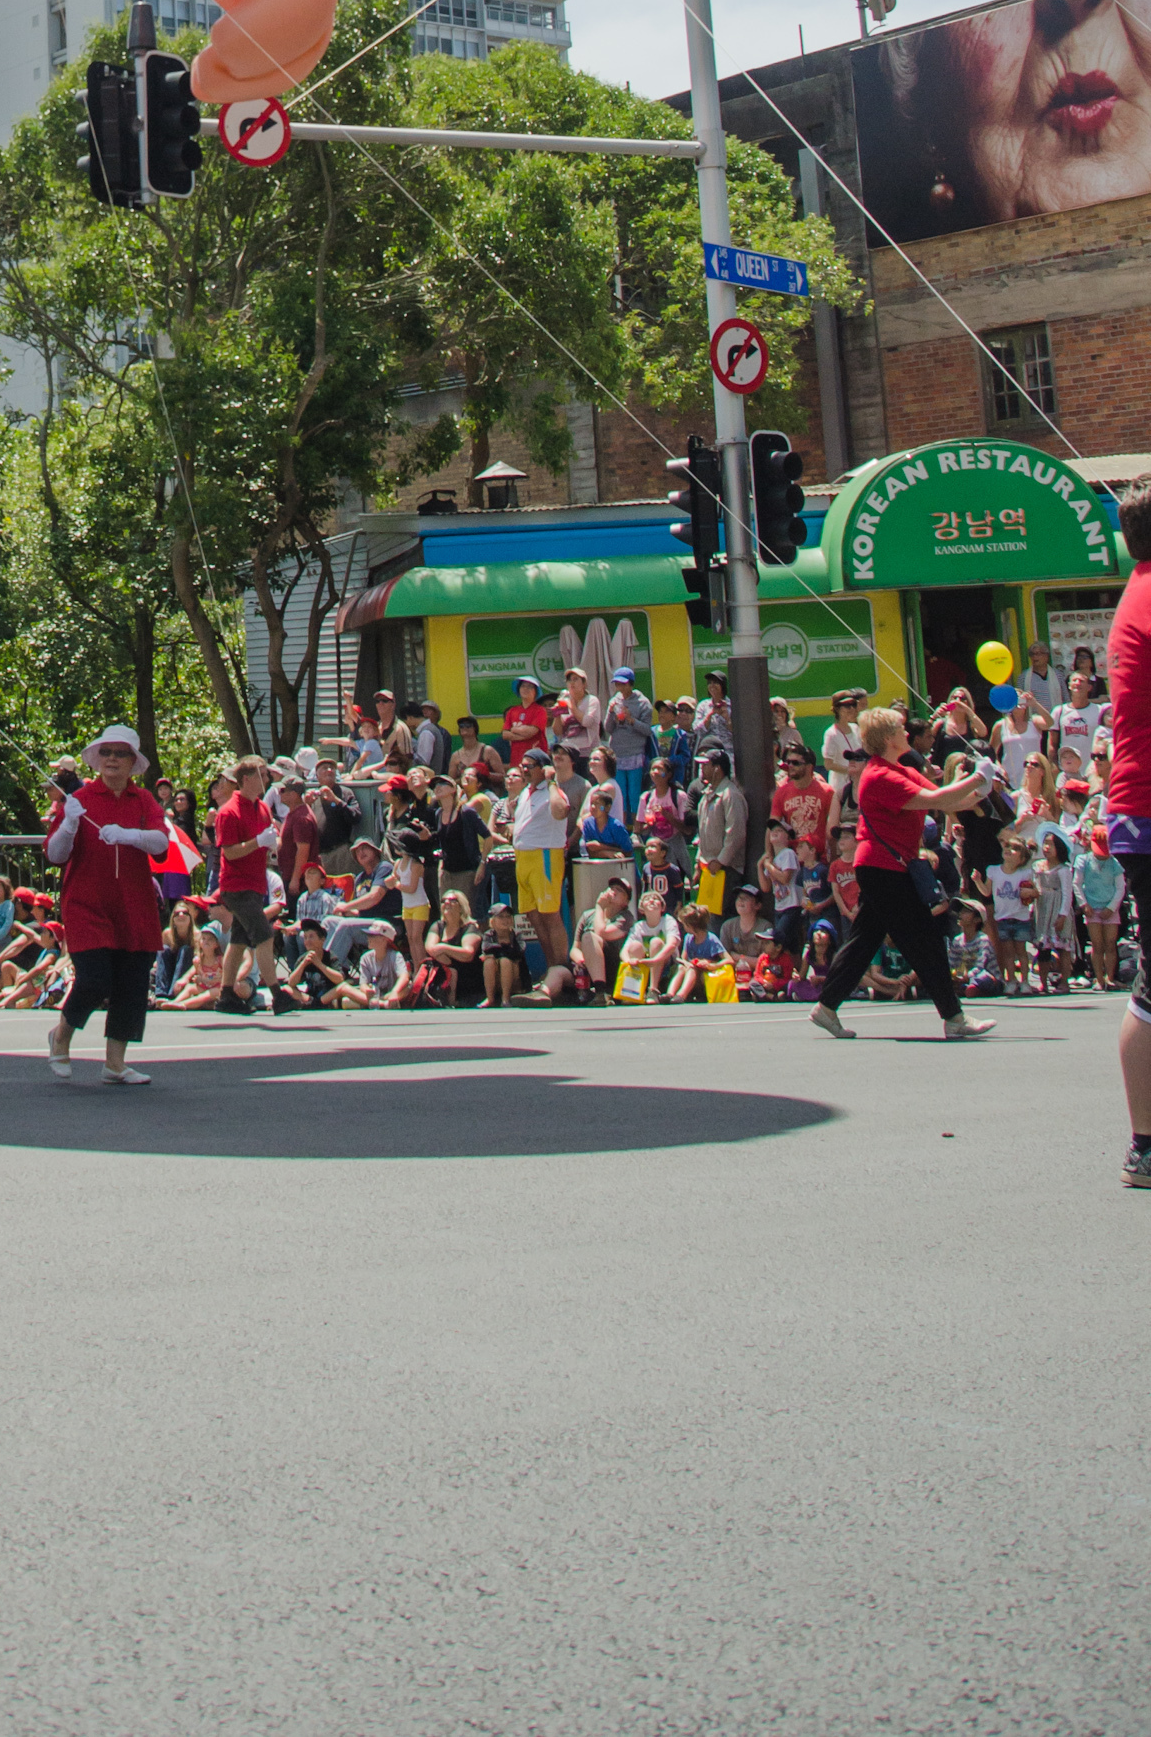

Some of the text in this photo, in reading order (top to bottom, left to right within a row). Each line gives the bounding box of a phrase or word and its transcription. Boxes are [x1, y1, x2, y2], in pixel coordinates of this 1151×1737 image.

[735, 252, 779, 282] QUEEN ST
[852, 448, 1110, 580] KOREAN RESTAURANT
[929, 507, 1028, 541] 강남역
[934, 541, 1028, 556] KANGNAM STATION
[761, 642, 803, 660] 강남역
[815, 641, 859, 655] STATION
[472, 660, 526, 673] KANGNAM
[537, 655, 564, 673] 강남
[783, 794, 822, 812] CHELSEA
